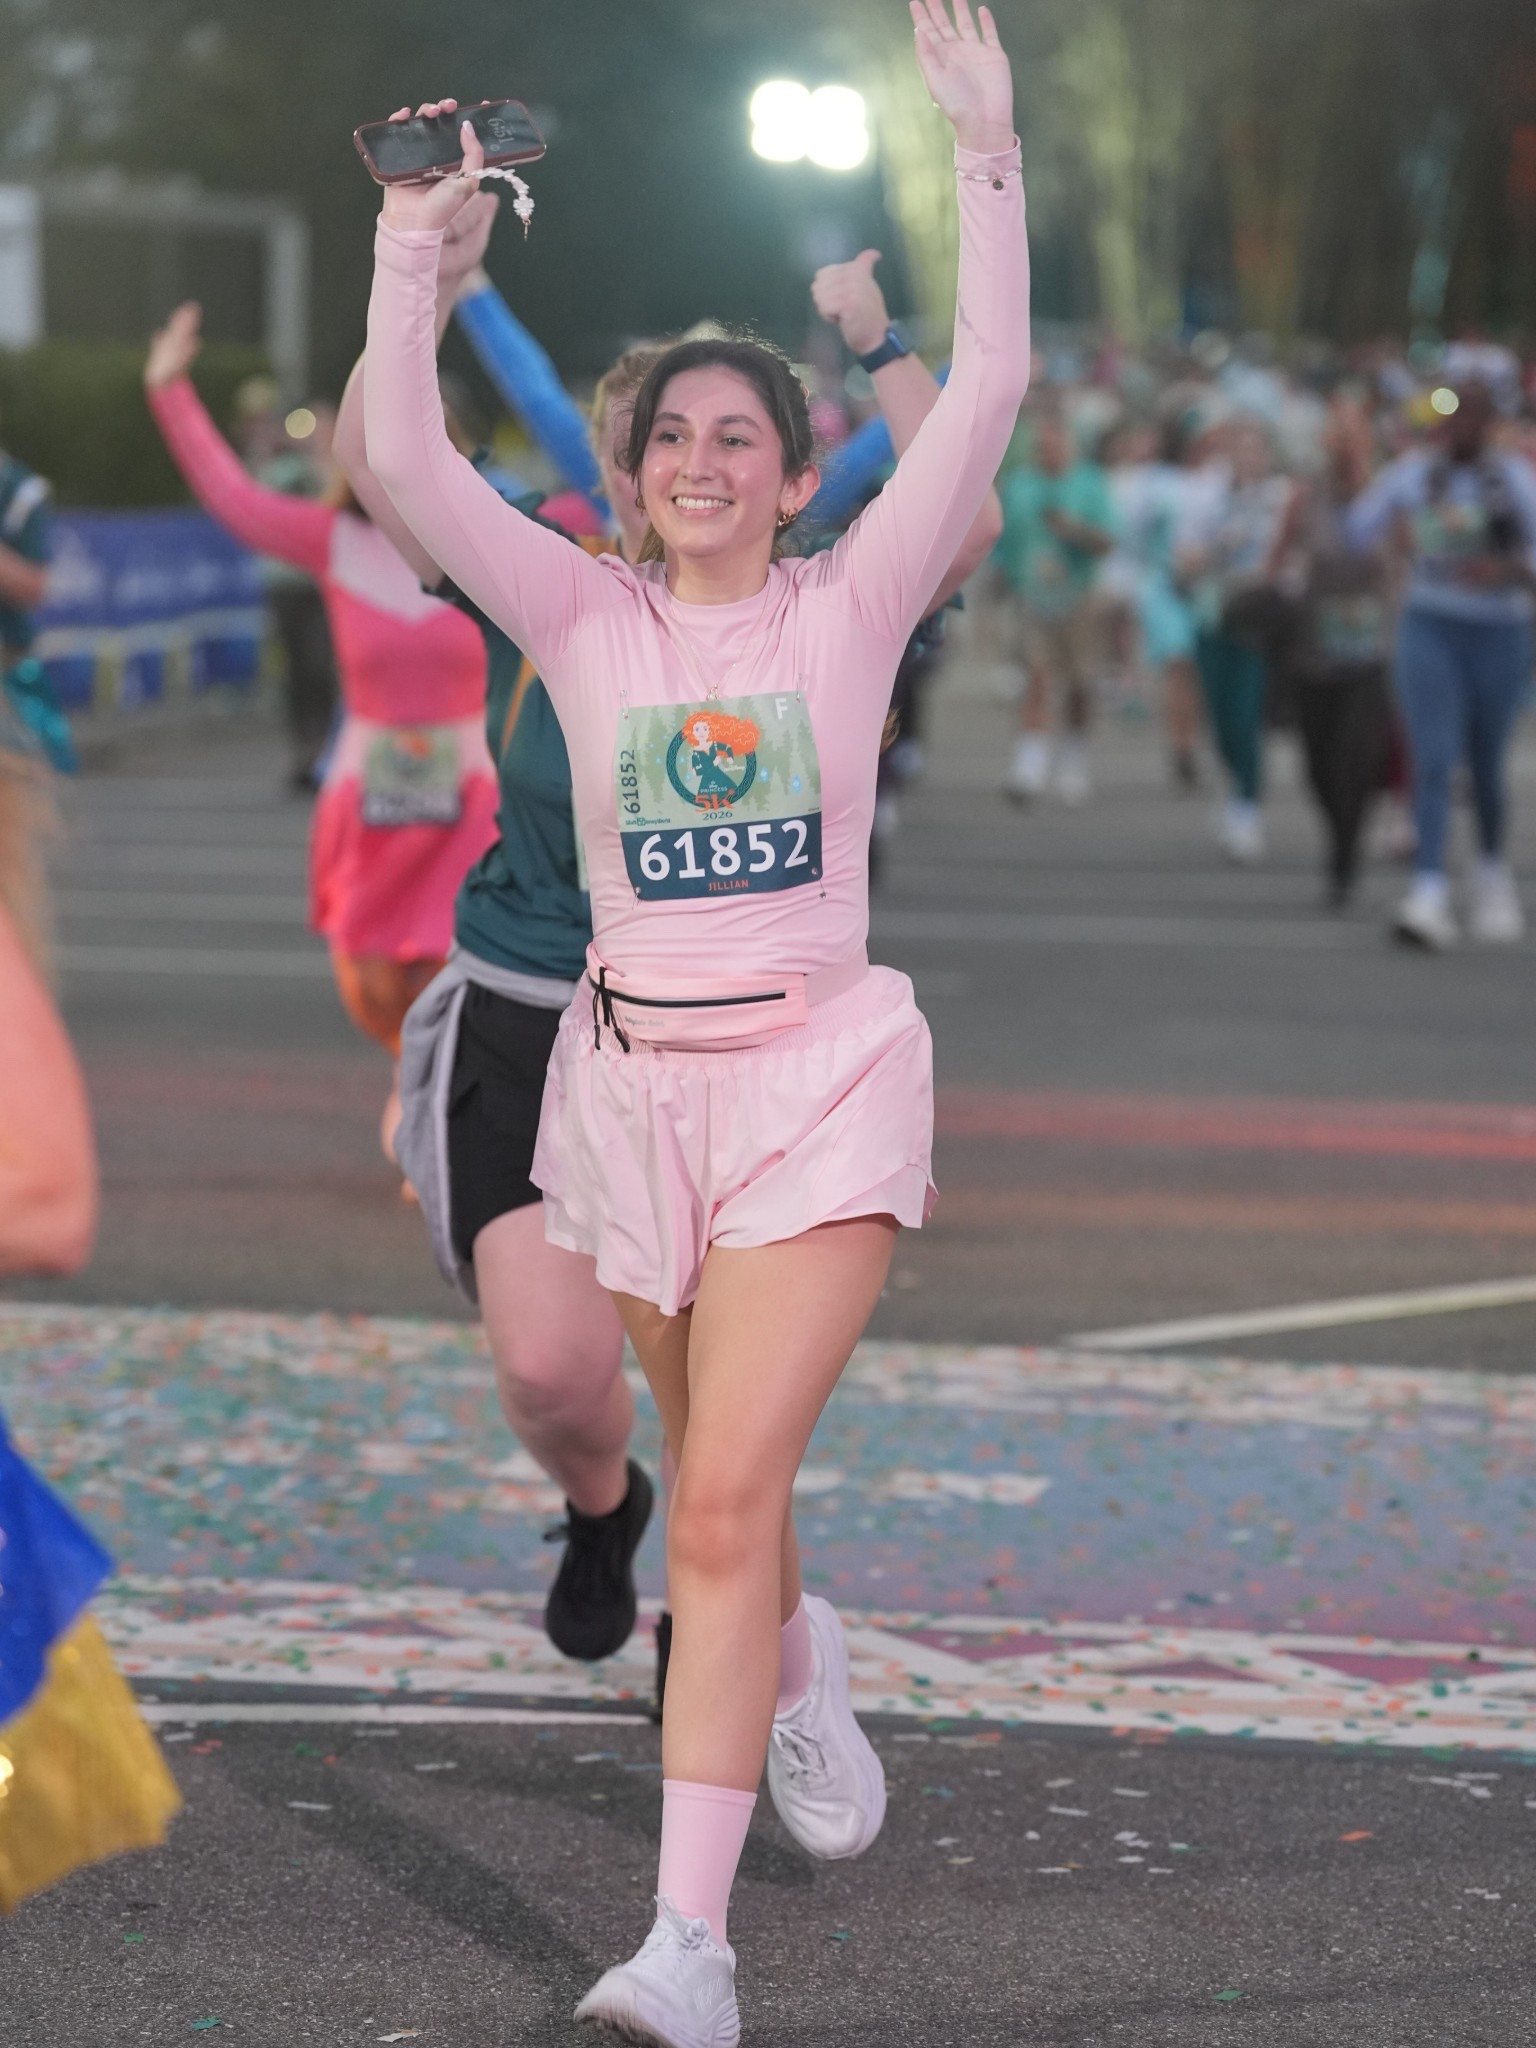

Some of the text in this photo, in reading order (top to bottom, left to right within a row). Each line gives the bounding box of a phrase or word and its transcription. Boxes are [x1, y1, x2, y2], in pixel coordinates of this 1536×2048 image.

[488, 118, 515, 144] 6:51
[775, 698, 788, 719] F
[620, 750, 641, 814] 61852
[695, 789, 734, 812] 5K
[702, 811, 733, 821] 2026
[639, 819, 809, 881] 61852
[708, 879, 749, 892] JILLIAN
